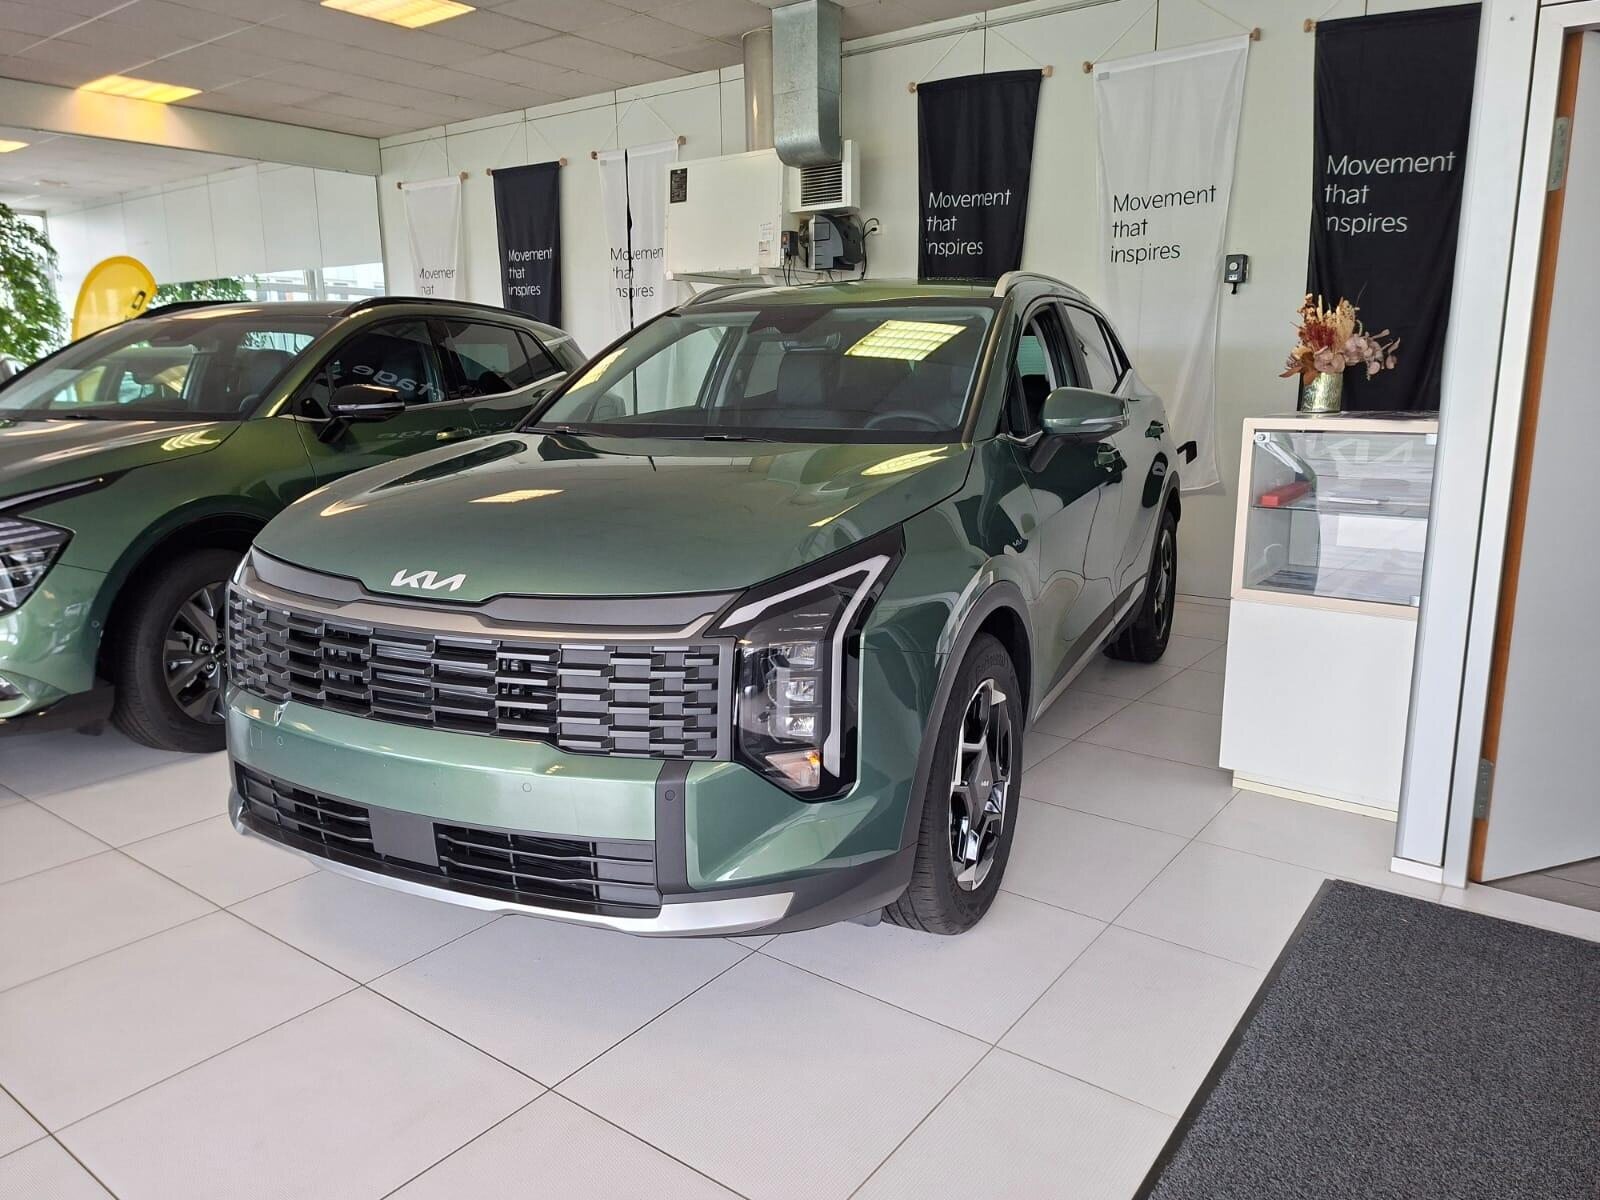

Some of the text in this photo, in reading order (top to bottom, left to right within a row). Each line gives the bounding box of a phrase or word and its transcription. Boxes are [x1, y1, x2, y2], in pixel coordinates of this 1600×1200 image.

[1326, 151, 1457, 176] Movement
[928, 188, 1012, 209] Movement
[1113, 184, 1217, 213] Movement
[1324, 183, 1371, 205] that
[926, 215, 958, 232] that
[1111, 218, 1149, 238] that
[1326, 212, 1409, 237] nspires
[508, 247, 553, 263] Movement
[610, 247, 665, 261] Movemen
[1110, 242, 1181, 265] inspires
[508, 266, 526, 280] that
[612, 266, 634, 280] hat
[508, 282, 541, 298] inspires
[615, 284, 655, 299] nspires
[390, 568, 467, 592] KIA
